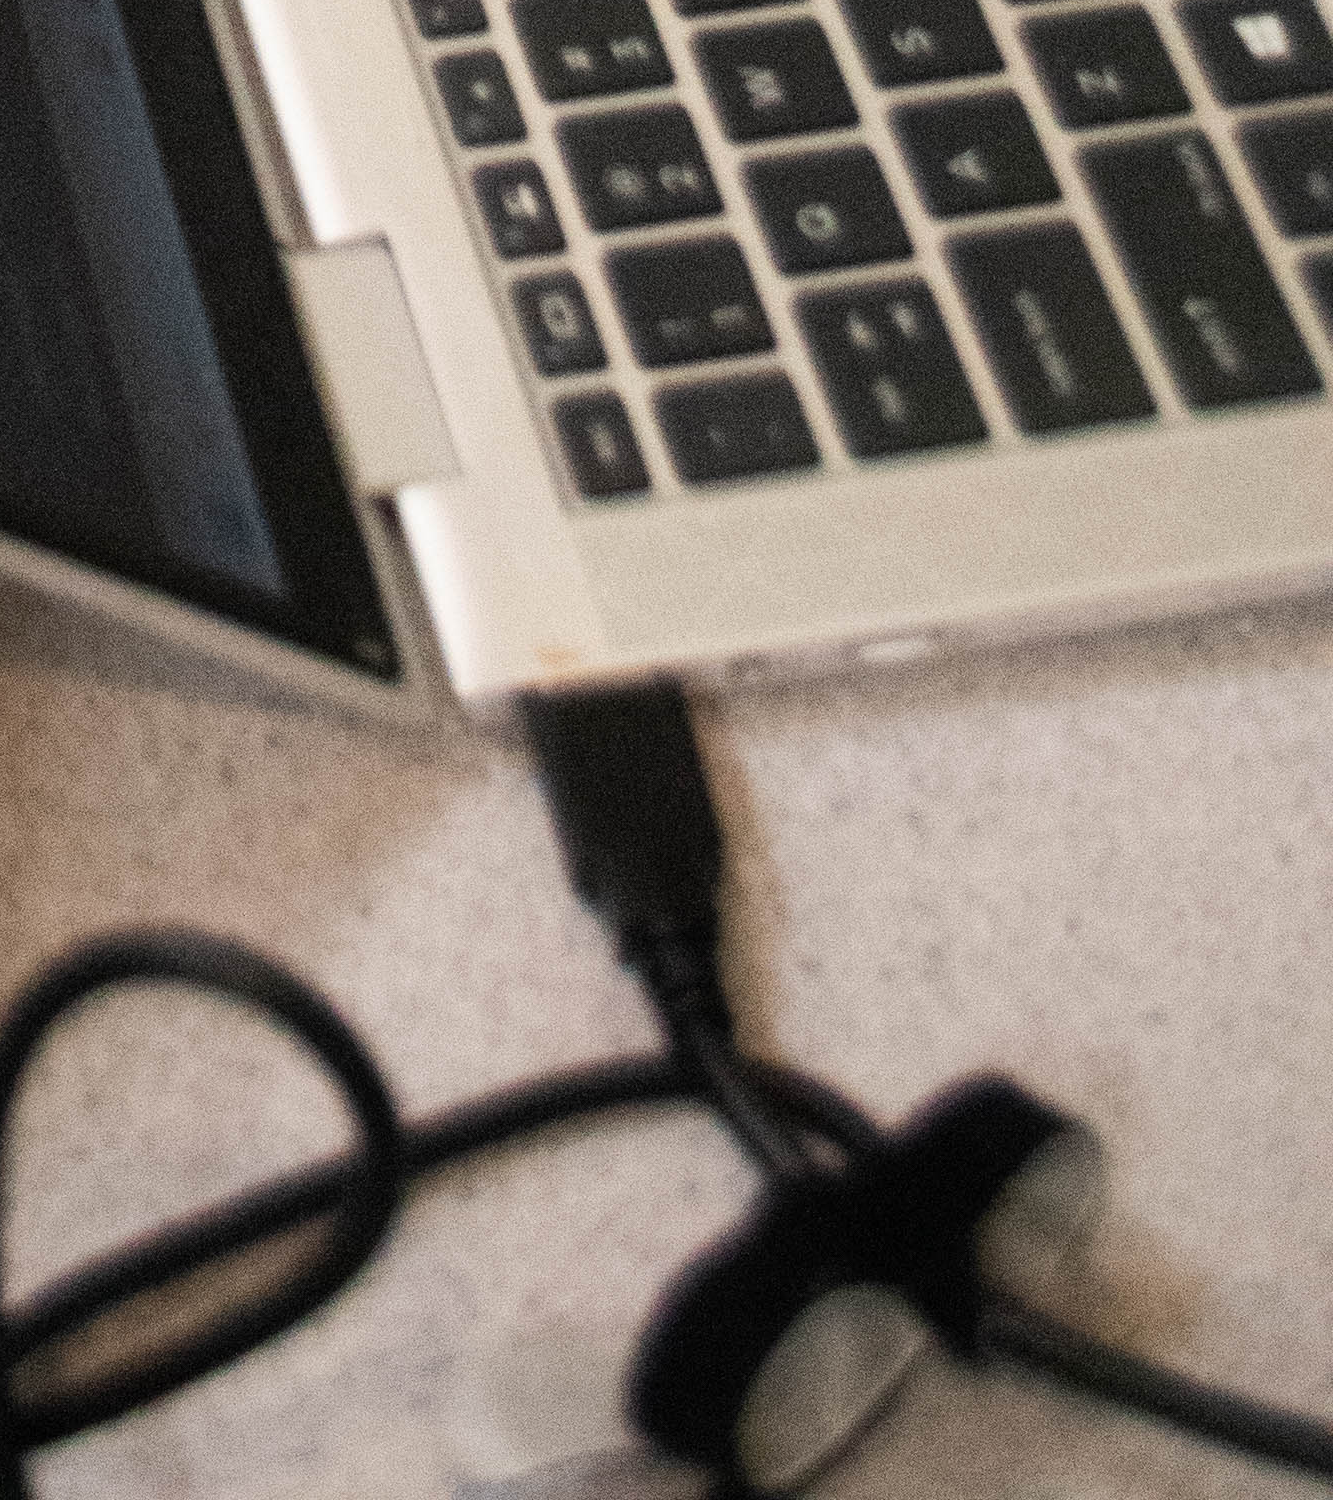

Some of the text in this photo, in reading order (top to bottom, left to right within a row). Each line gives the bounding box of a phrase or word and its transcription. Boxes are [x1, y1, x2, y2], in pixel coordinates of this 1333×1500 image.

[611, 38, 649, 59] 3
[892, 28, 932, 55] S
[743, 69, 783, 107] W
[1076, 71, 1120, 93] Z
[949, 150, 985, 181] A
[660, 167, 698, 189] 2
